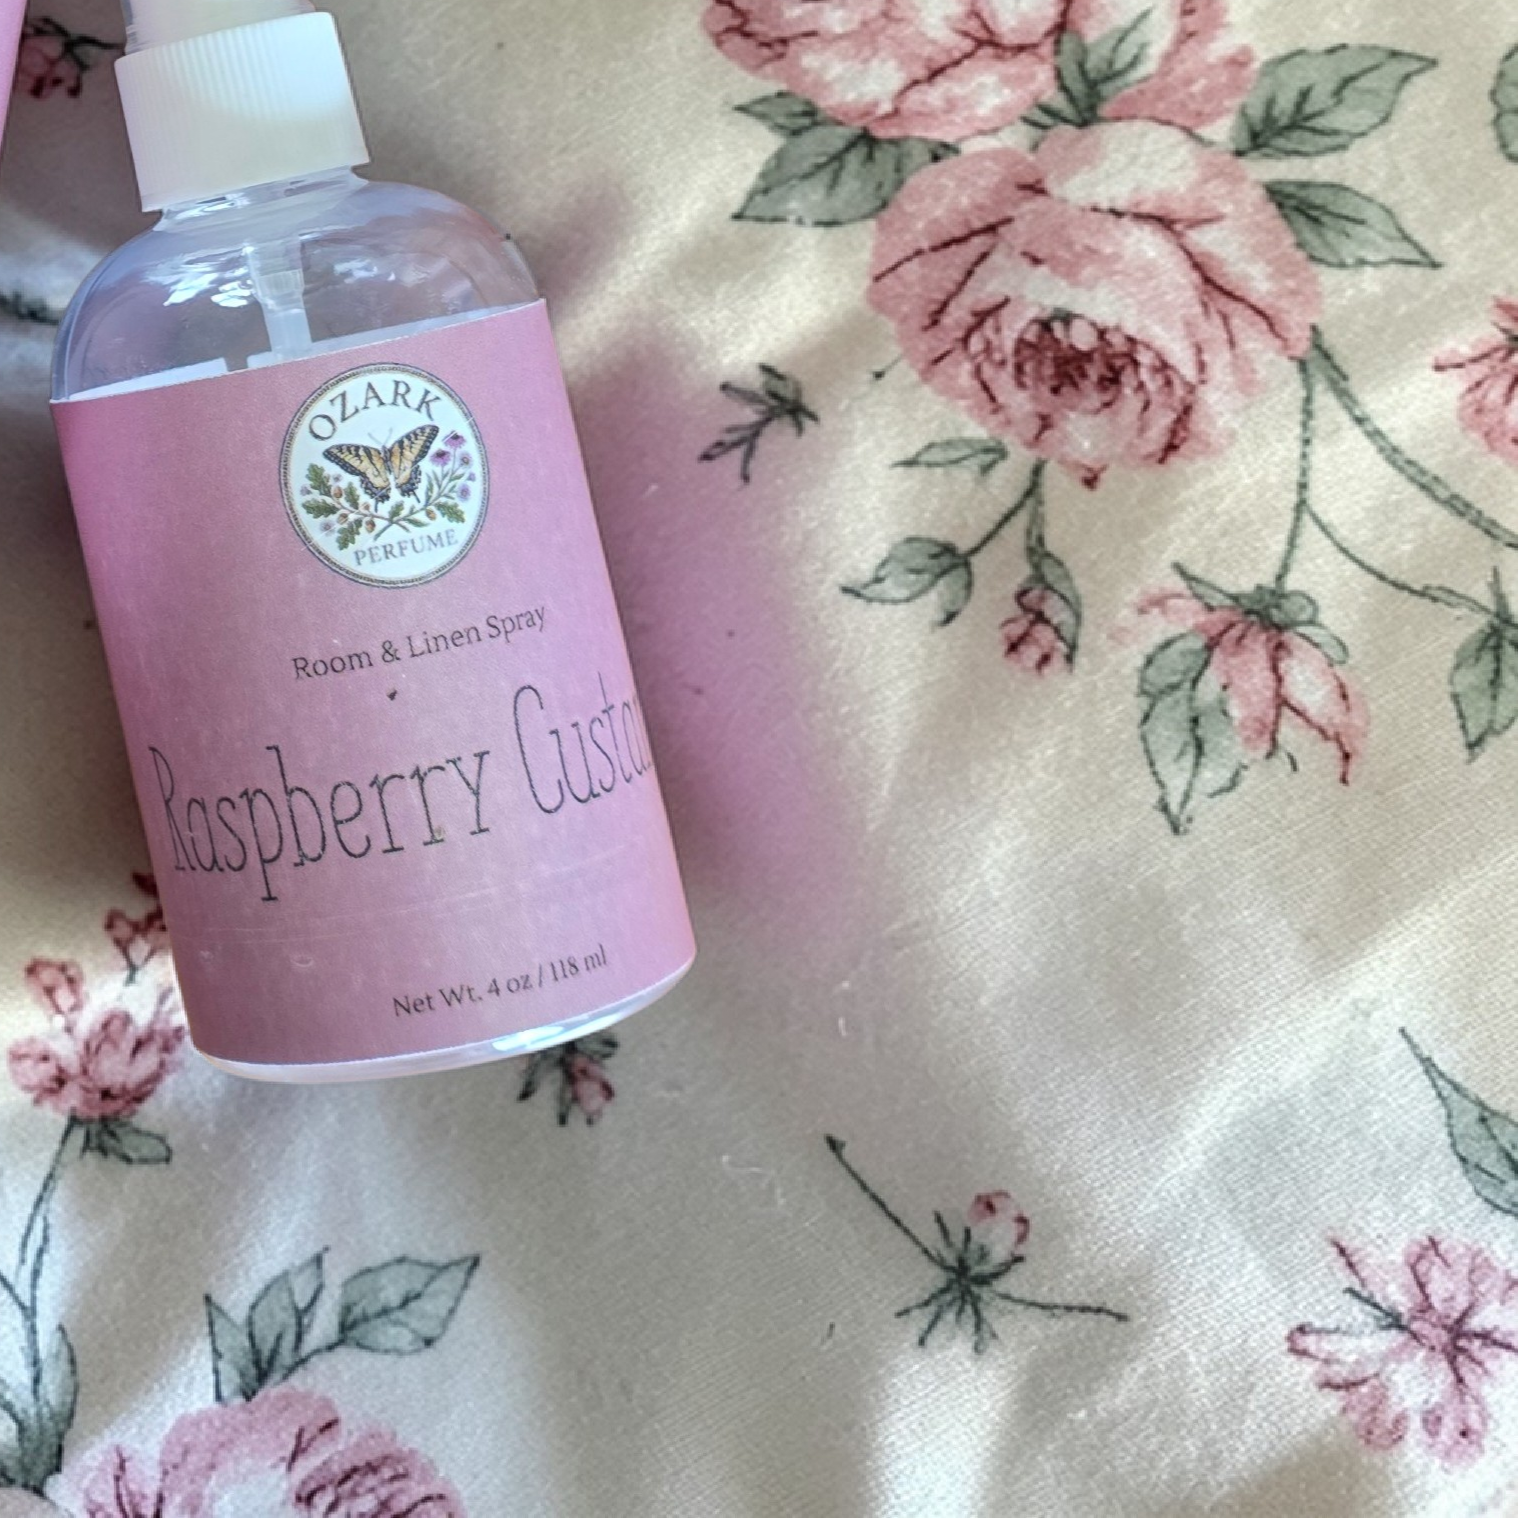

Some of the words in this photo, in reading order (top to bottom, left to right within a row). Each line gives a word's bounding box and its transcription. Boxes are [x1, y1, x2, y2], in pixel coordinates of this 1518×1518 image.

[308, 379, 442, 442] OZARK
[353, 528, 459, 567] PERFUME
[292, 648, 375, 680] Room
[381, 639, 401, 664] &
[406, 625, 483, 659] Linen
[485, 606, 546, 644] Spray
[148, 744, 491, 902] Raspberry
[392, 992, 435, 1017] Net
[438, 983, 483, 1008] Wt.
[486, 977, 501, 998] 4
[506, 973, 533, 994] oz
[537, 963, 544, 988] /
[549, 956, 580, 983] 118
[583, 943, 608, 973] ml
